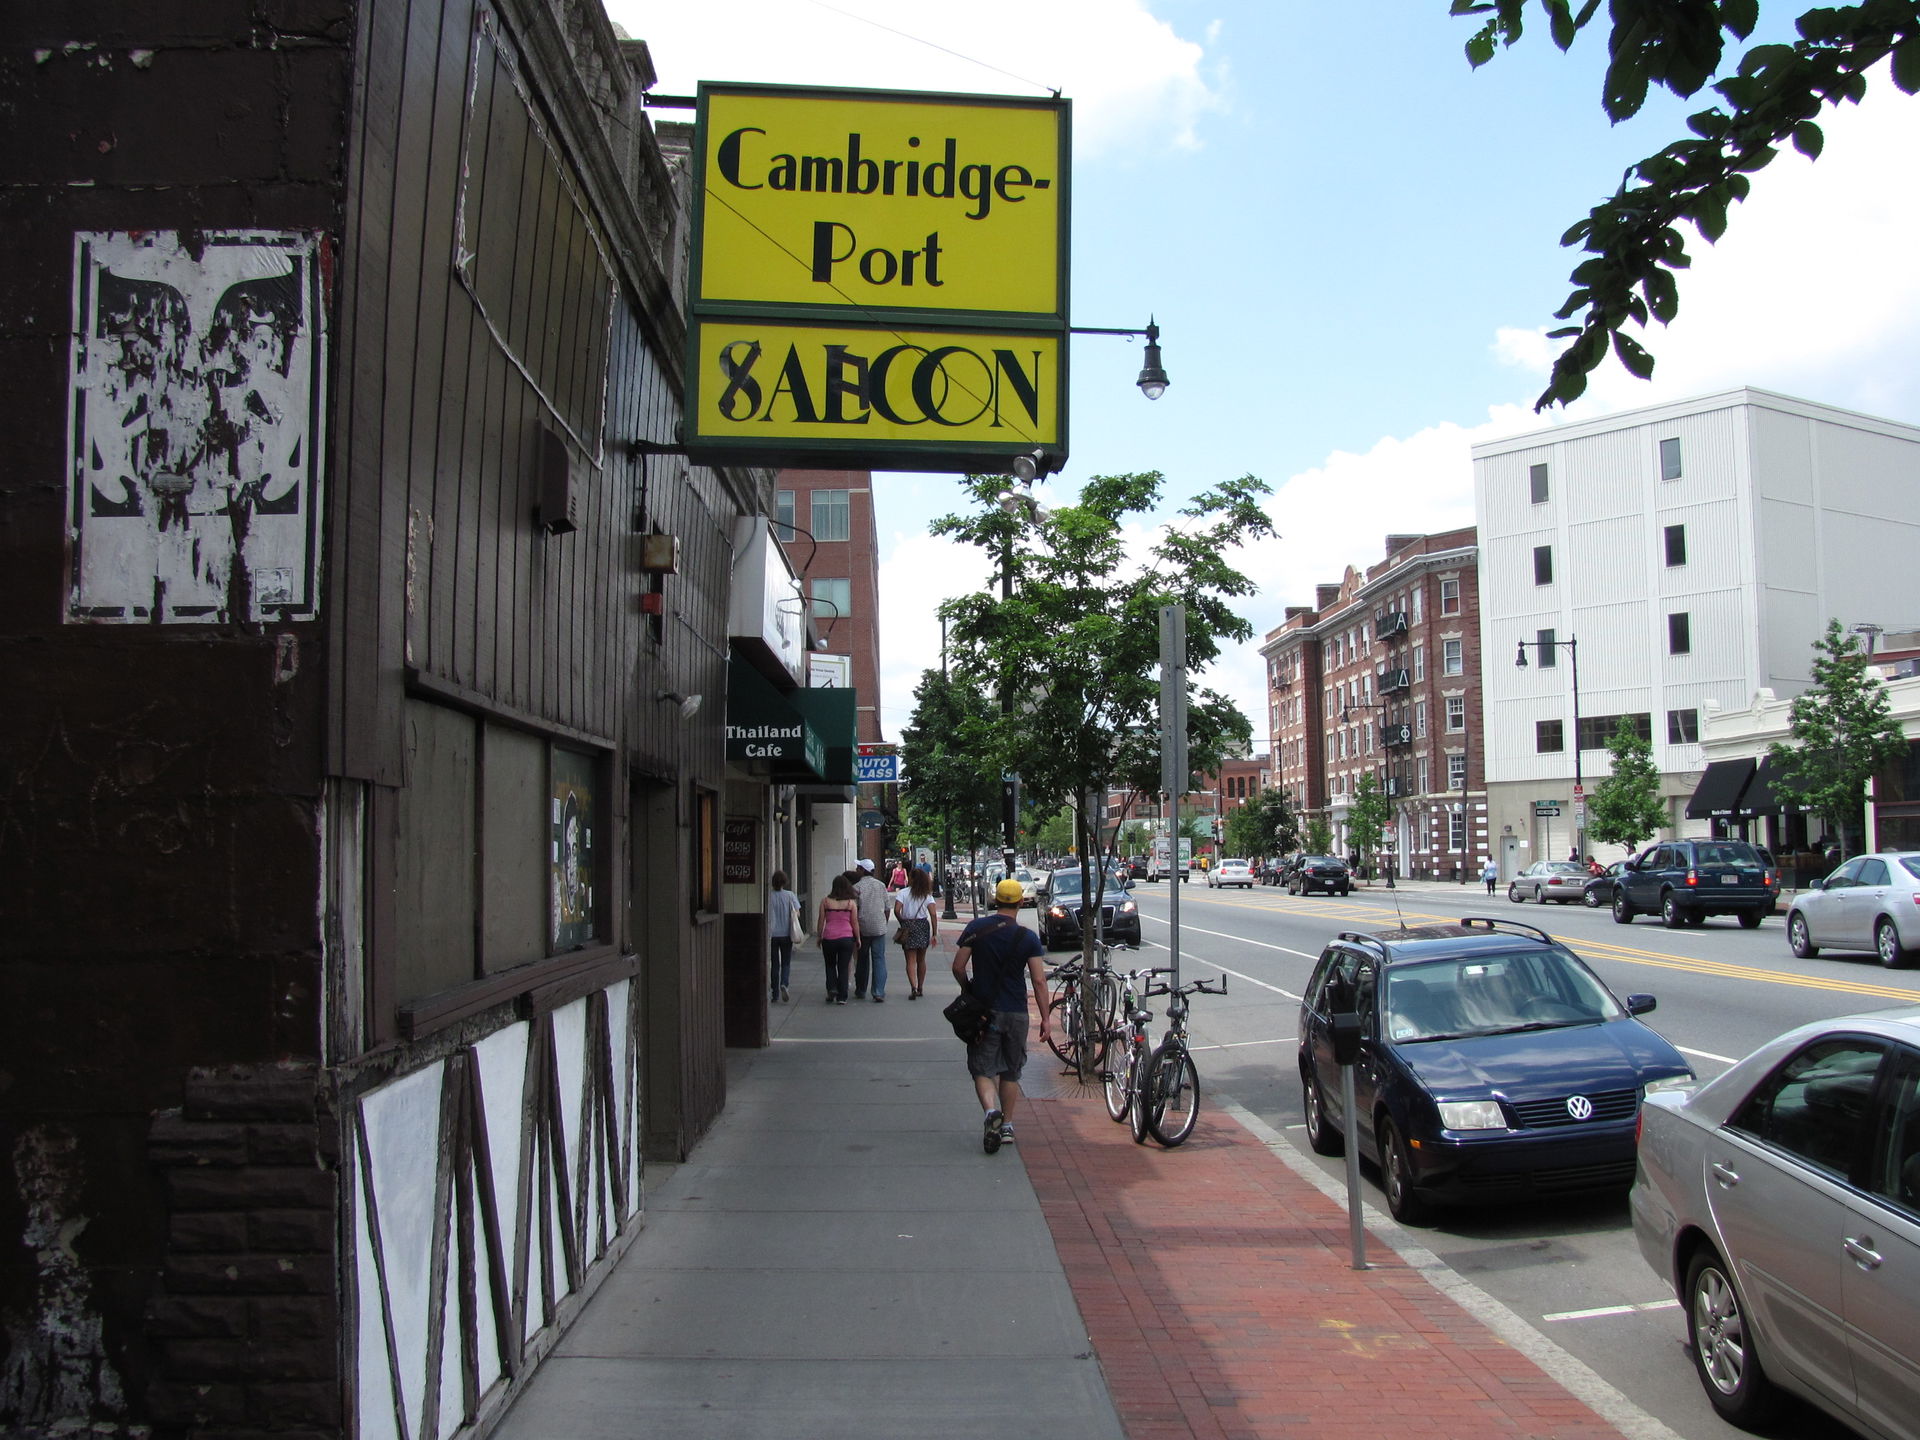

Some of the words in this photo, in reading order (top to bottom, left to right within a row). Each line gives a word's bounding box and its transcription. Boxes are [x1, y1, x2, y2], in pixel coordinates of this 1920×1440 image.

[717, 127, 1051, 220] Cambridge-
[812, 220, 945, 287] Port
[726, 725, 802, 739] Thailand
[745, 743, 783, 757] Cafe
[858, 768, 894, 779] LASS
